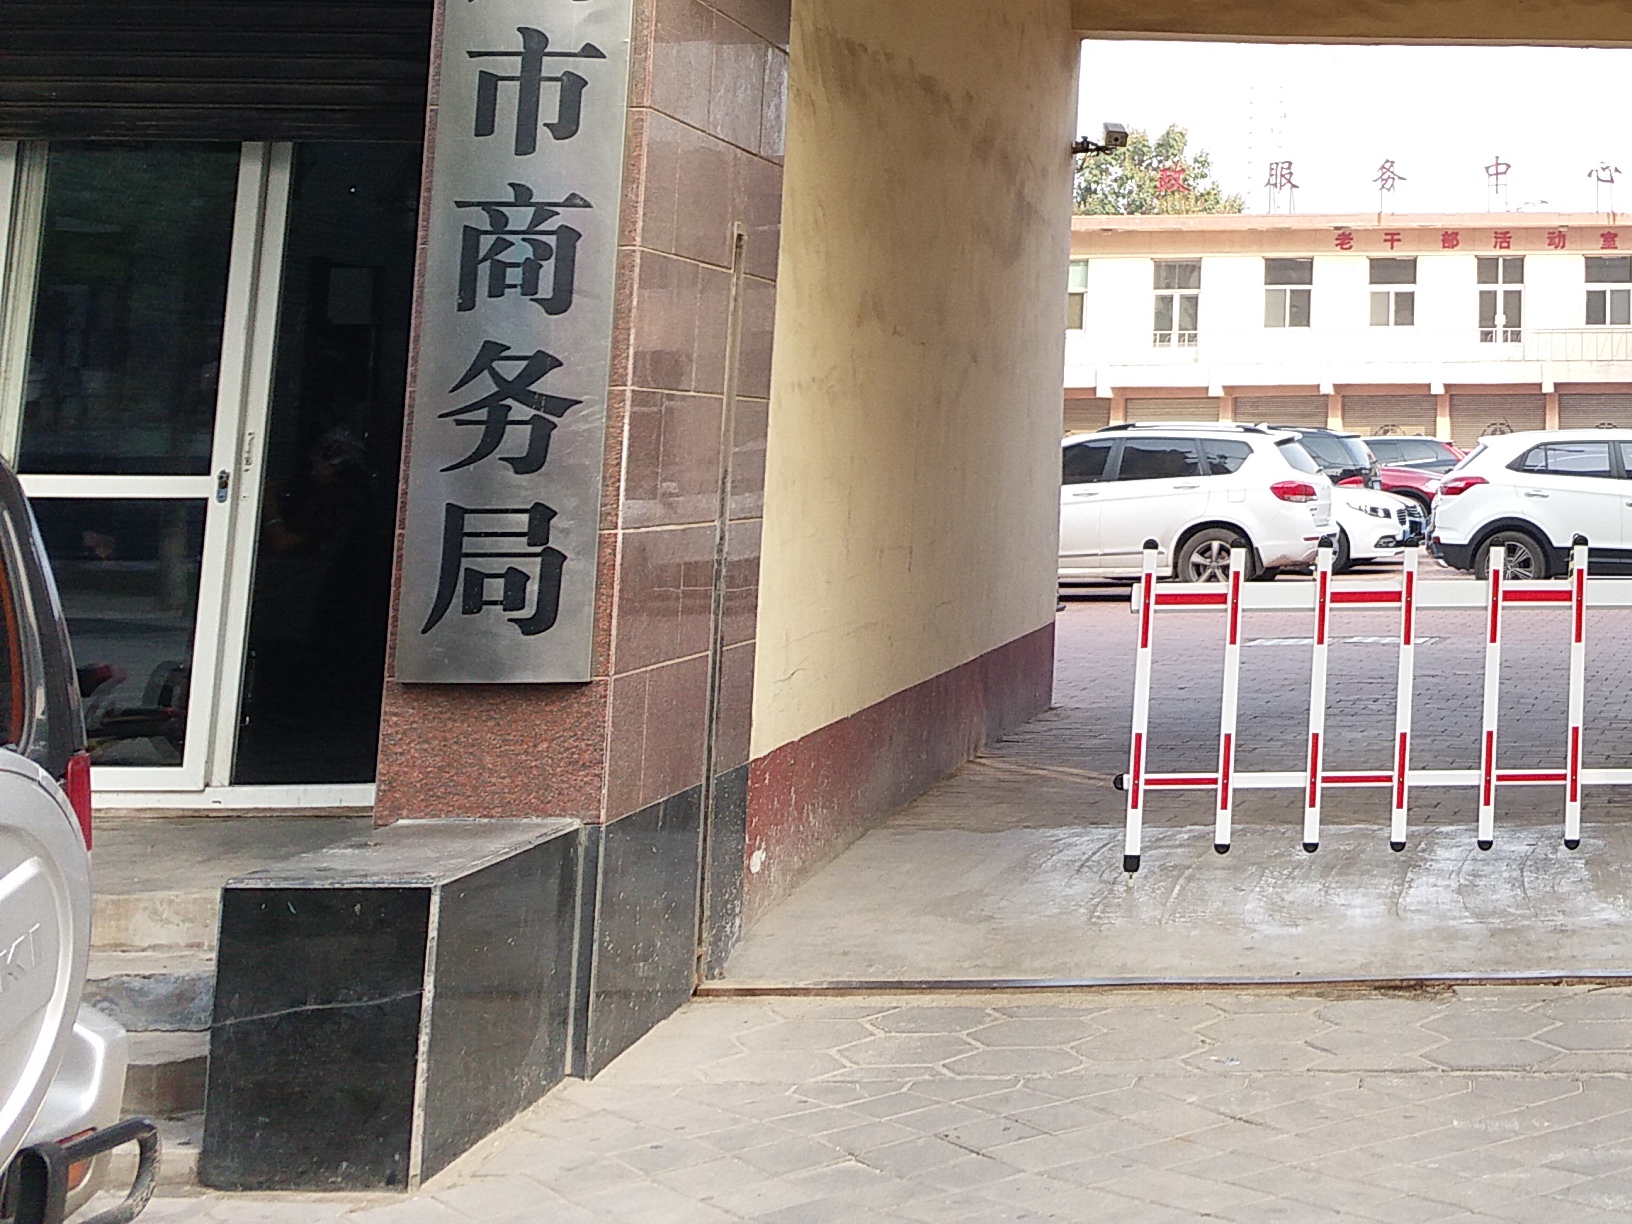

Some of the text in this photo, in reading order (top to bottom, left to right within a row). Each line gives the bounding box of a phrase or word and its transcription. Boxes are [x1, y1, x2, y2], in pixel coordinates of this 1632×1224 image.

[1335, 230, 1619, 251] 老干部活动室
